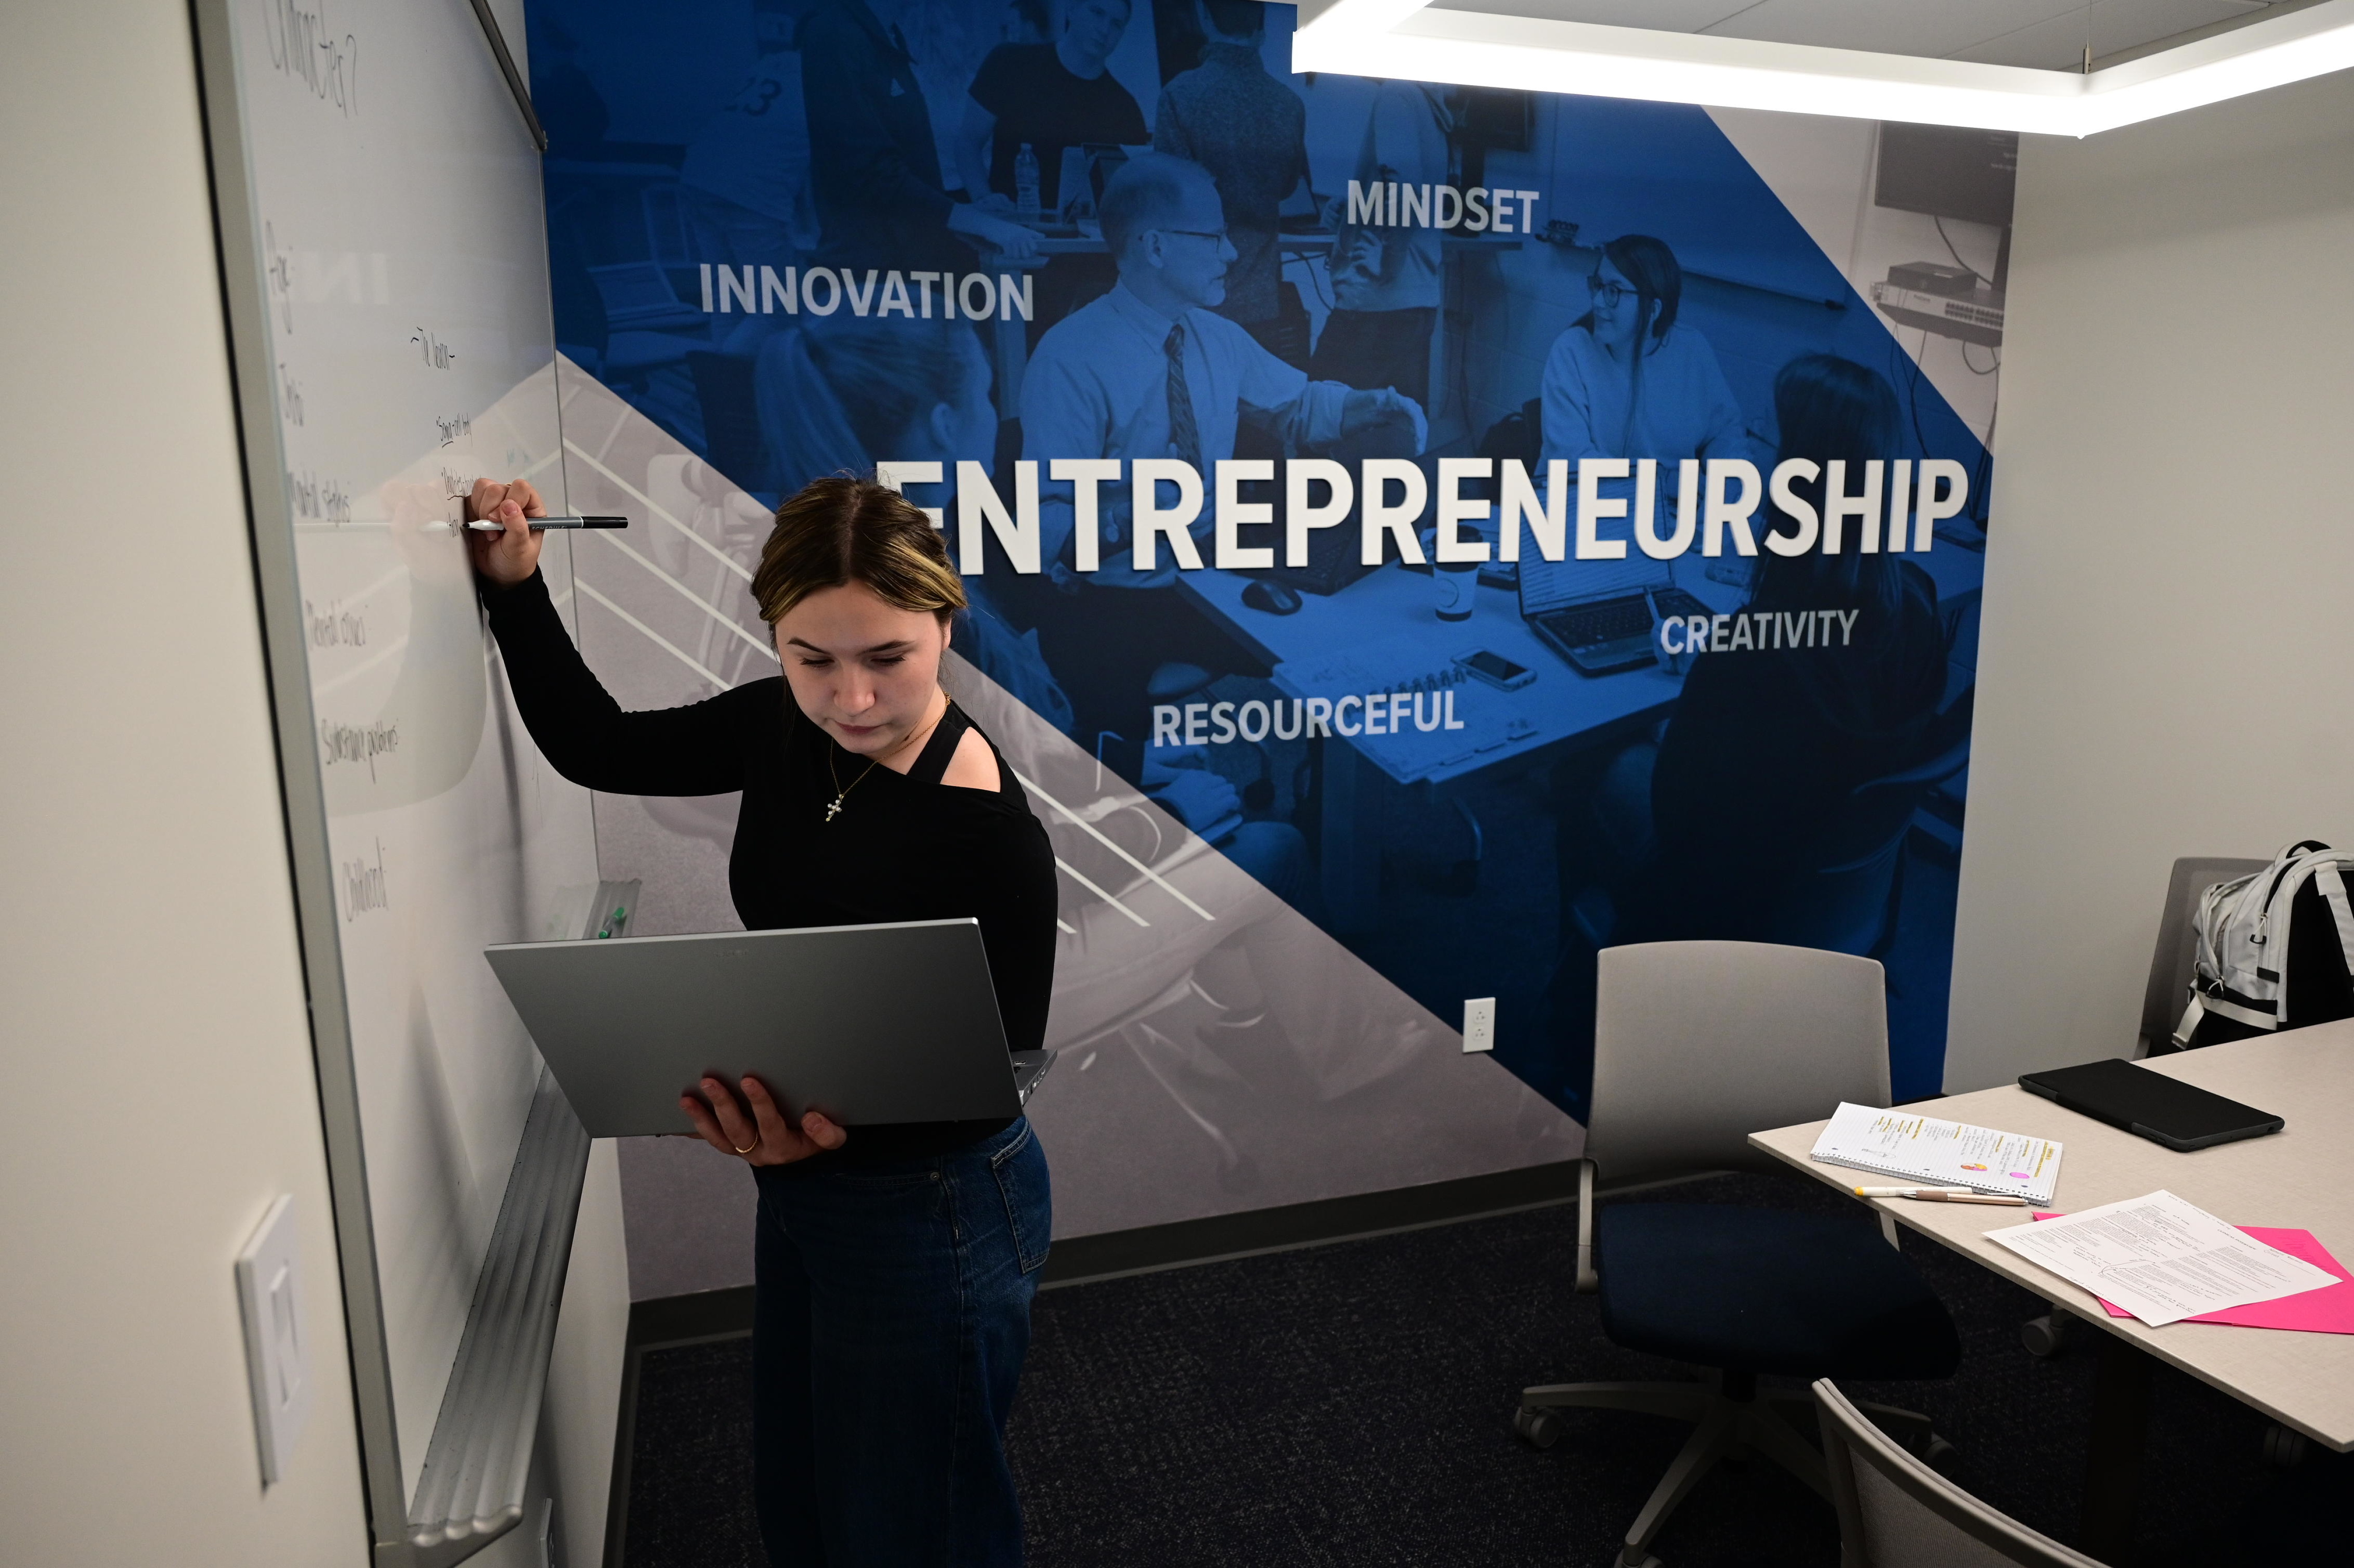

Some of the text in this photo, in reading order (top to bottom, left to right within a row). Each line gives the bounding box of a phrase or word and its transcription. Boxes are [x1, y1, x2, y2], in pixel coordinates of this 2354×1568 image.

[1347, 179, 1540, 234] MINDSET
[700, 264, 1033, 321] INNOVATION
[1660, 609, 1859, 654] CREATIVITY
[1153, 690, 1465, 748] RESOURCEFUL
